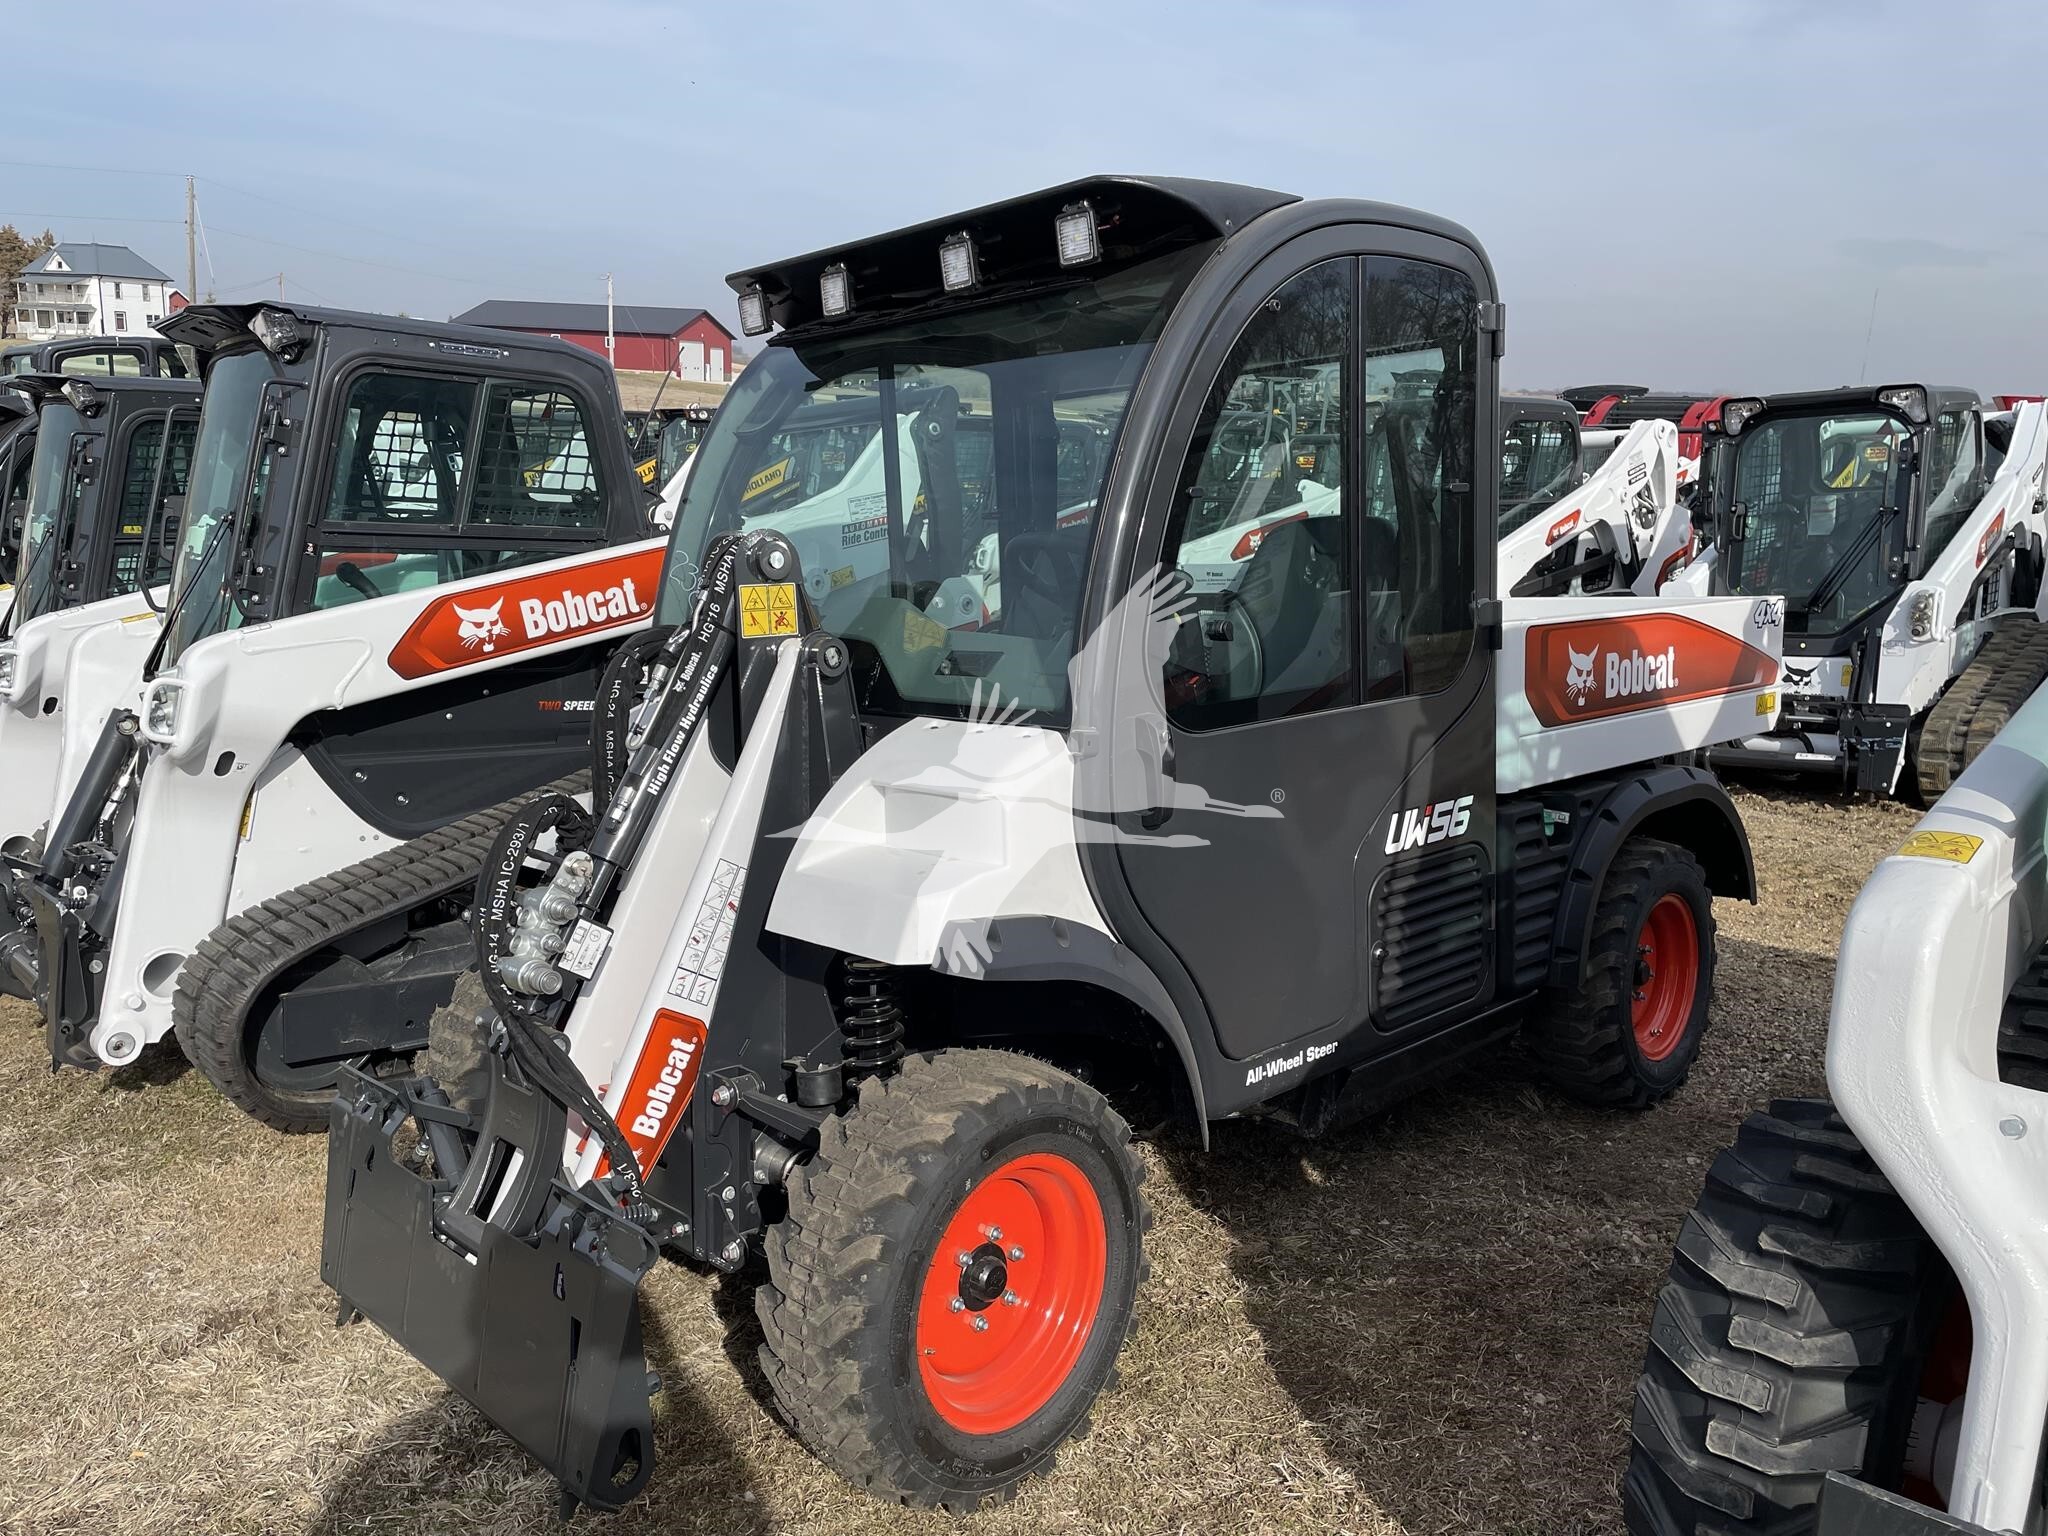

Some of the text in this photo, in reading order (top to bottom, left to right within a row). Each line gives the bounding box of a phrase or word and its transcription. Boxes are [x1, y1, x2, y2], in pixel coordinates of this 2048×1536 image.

[842, 516, 888, 534] AUTOMATI
[842, 527, 888, 547] Ride Contr
[519, 577, 640, 639] Bobcat
[697, 602, 721, 643] HG-16
[714, 554, 735, 594] MSHA
[1754, 598, 1784, 629] 4x4
[680, 651, 702, 682] Bobcat
[1605, 645, 1675, 699] Bobcat
[538, 700, 596, 711] TWO SPEED
[607, 680, 622, 718] HG-24
[605, 730, 615, 768] MSHA
[647, 664, 719, 796] High Flow Hydraulics
[491, 879, 510, 921] MSHA
[502, 822, 530, 876] IC-293/1
[1246, 1041, 1339, 1086] All-Wheel Steer
[631, 1036, 696, 1139] Bobcat
